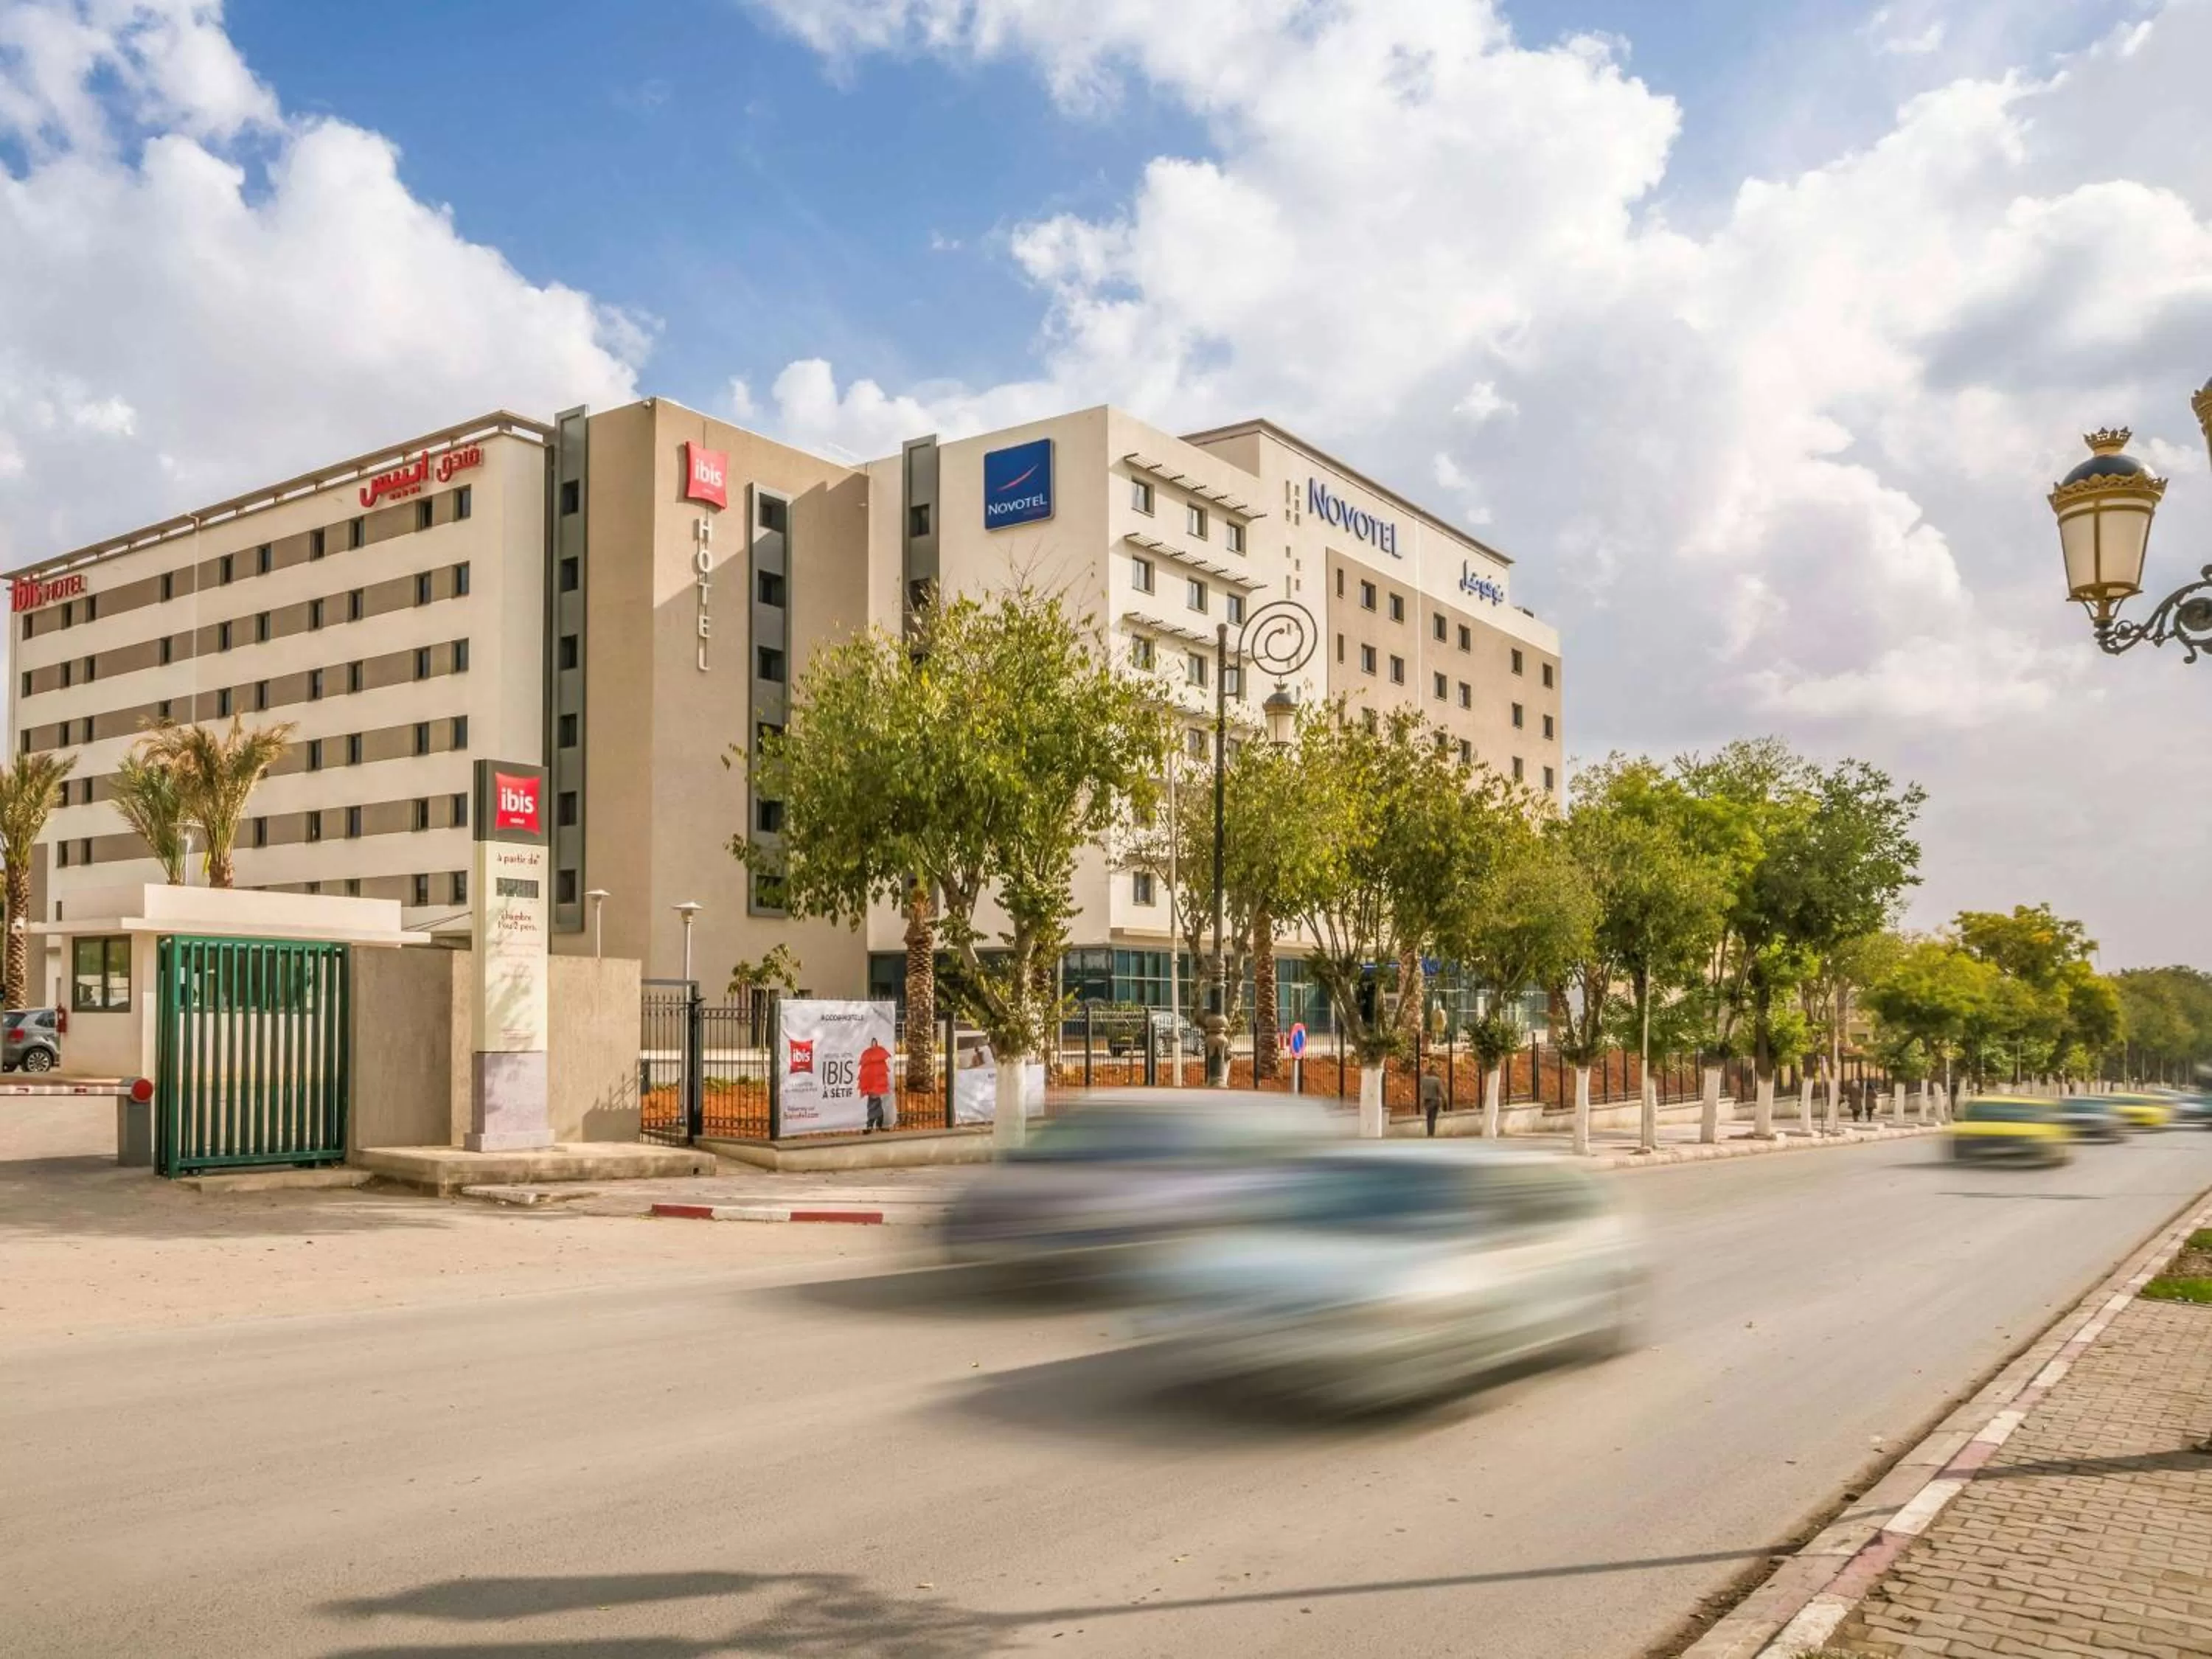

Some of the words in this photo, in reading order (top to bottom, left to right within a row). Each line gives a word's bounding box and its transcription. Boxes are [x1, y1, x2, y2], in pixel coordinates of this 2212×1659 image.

[437, 443, 484, 483] فندق
[695, 458, 723, 487] ibis
[988, 493, 1048, 515] NOVOTEL
[1309, 477, 1402, 559] NOVOTEL
[12, 574, 43, 612] ibis
[46, 574, 86, 601] HOTEL
[698, 518, 713, 671] HOTEL
[501, 787, 535, 814] ibis
[504, 854, 526, 866] partir
[793, 1048, 810, 1062] ibis
[822, 1060, 853, 1085] IBIS
